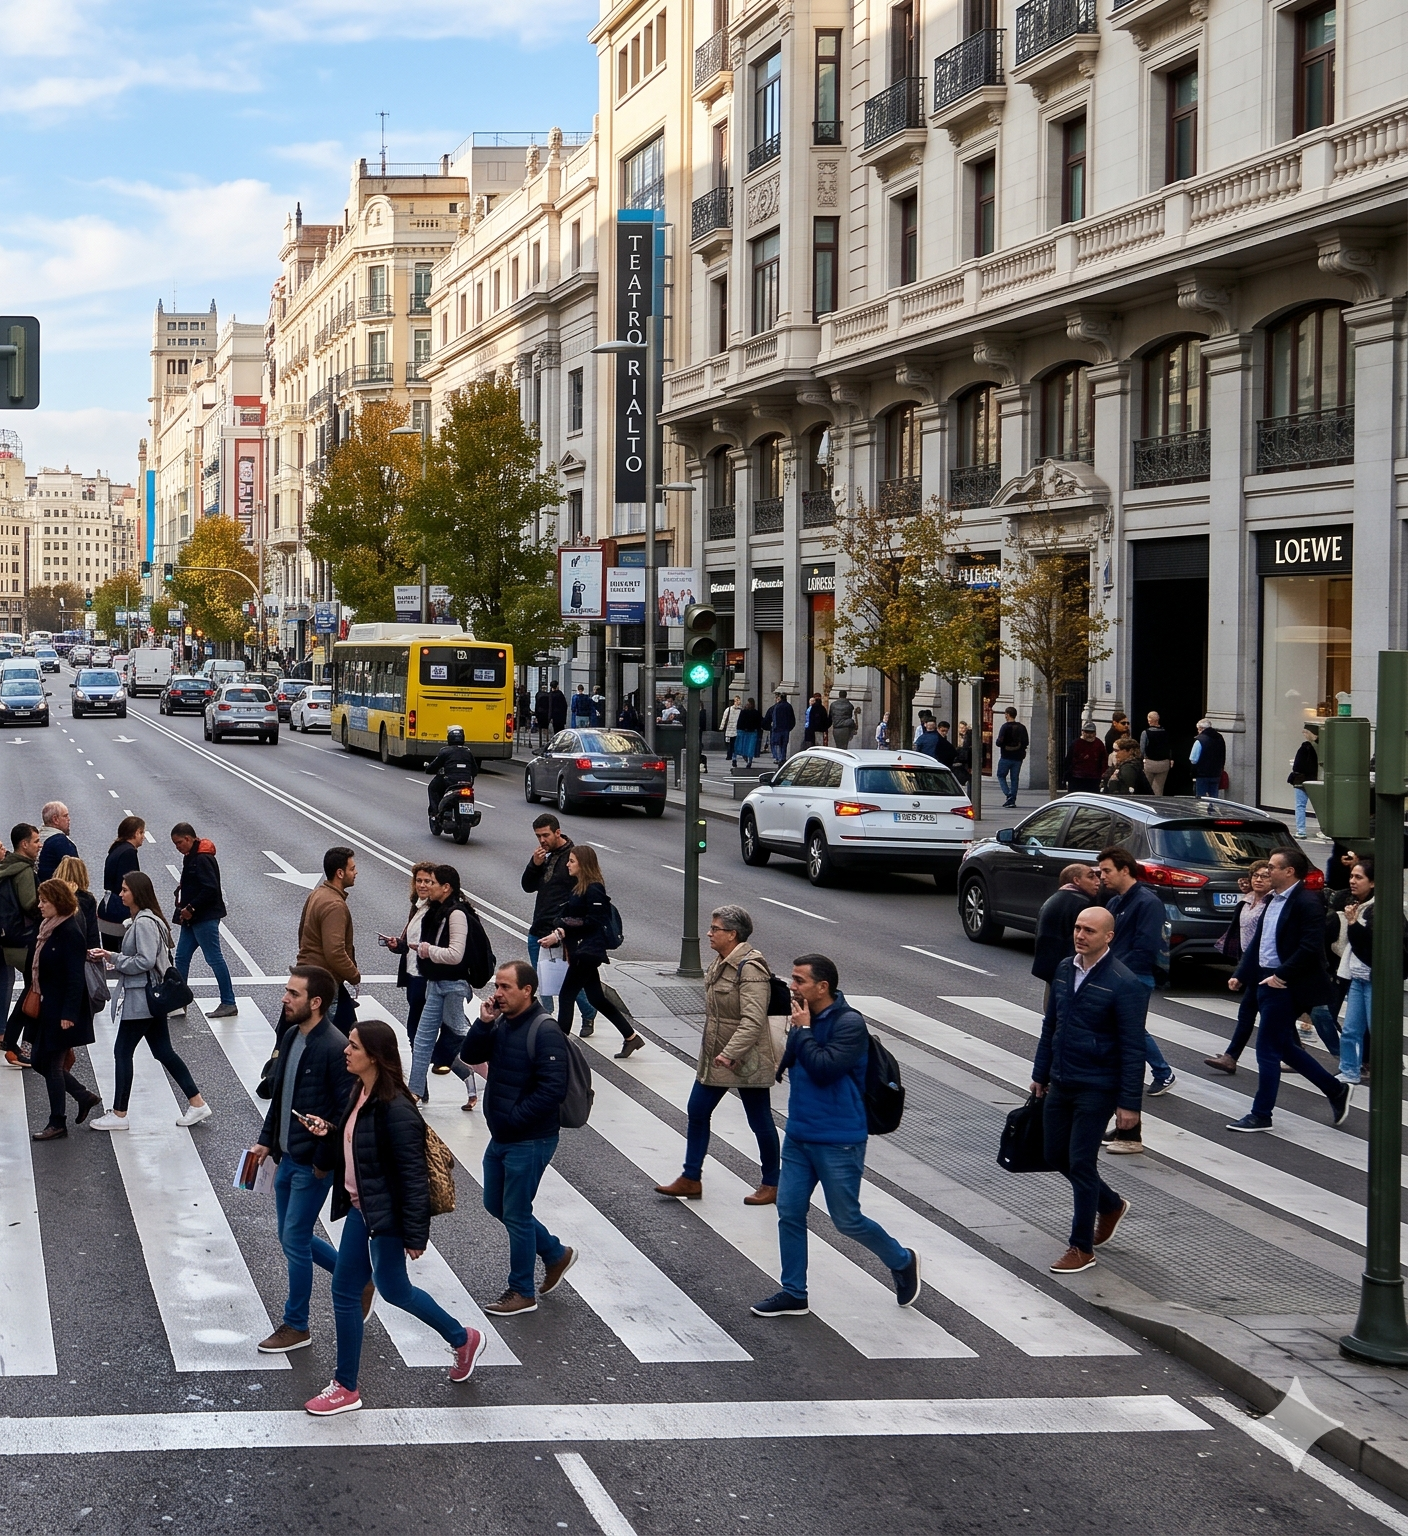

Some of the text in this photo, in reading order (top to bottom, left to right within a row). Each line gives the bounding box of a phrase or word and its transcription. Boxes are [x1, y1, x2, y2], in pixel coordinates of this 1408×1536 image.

[625, 235, 643, 473] TEATRO RIALTO
[1275, 536, 1343, 564] LOEWE
